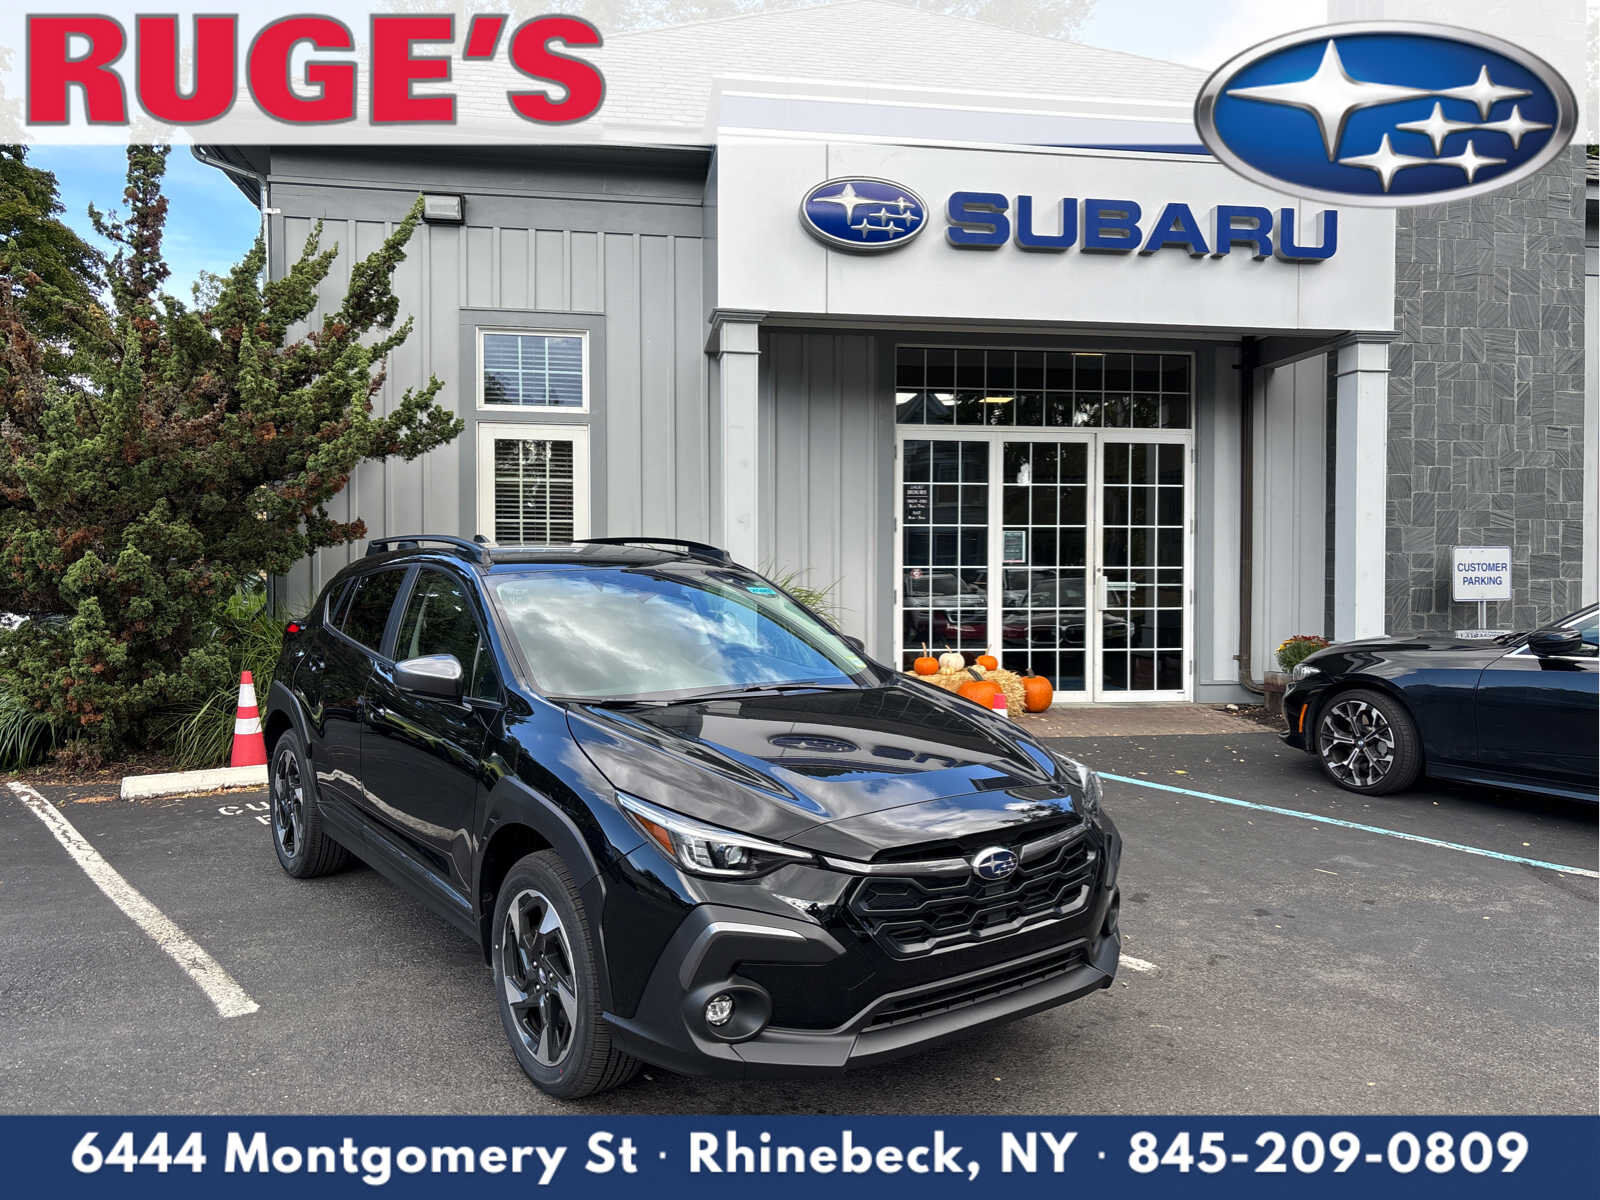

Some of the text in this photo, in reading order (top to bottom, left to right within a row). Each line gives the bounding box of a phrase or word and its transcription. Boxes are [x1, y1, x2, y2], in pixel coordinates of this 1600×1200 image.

[945, 190, 1338, 263] SUBARU
[1457, 562, 1508, 572] CUSTOMER
[1462, 576, 1503, 586] PARKING
